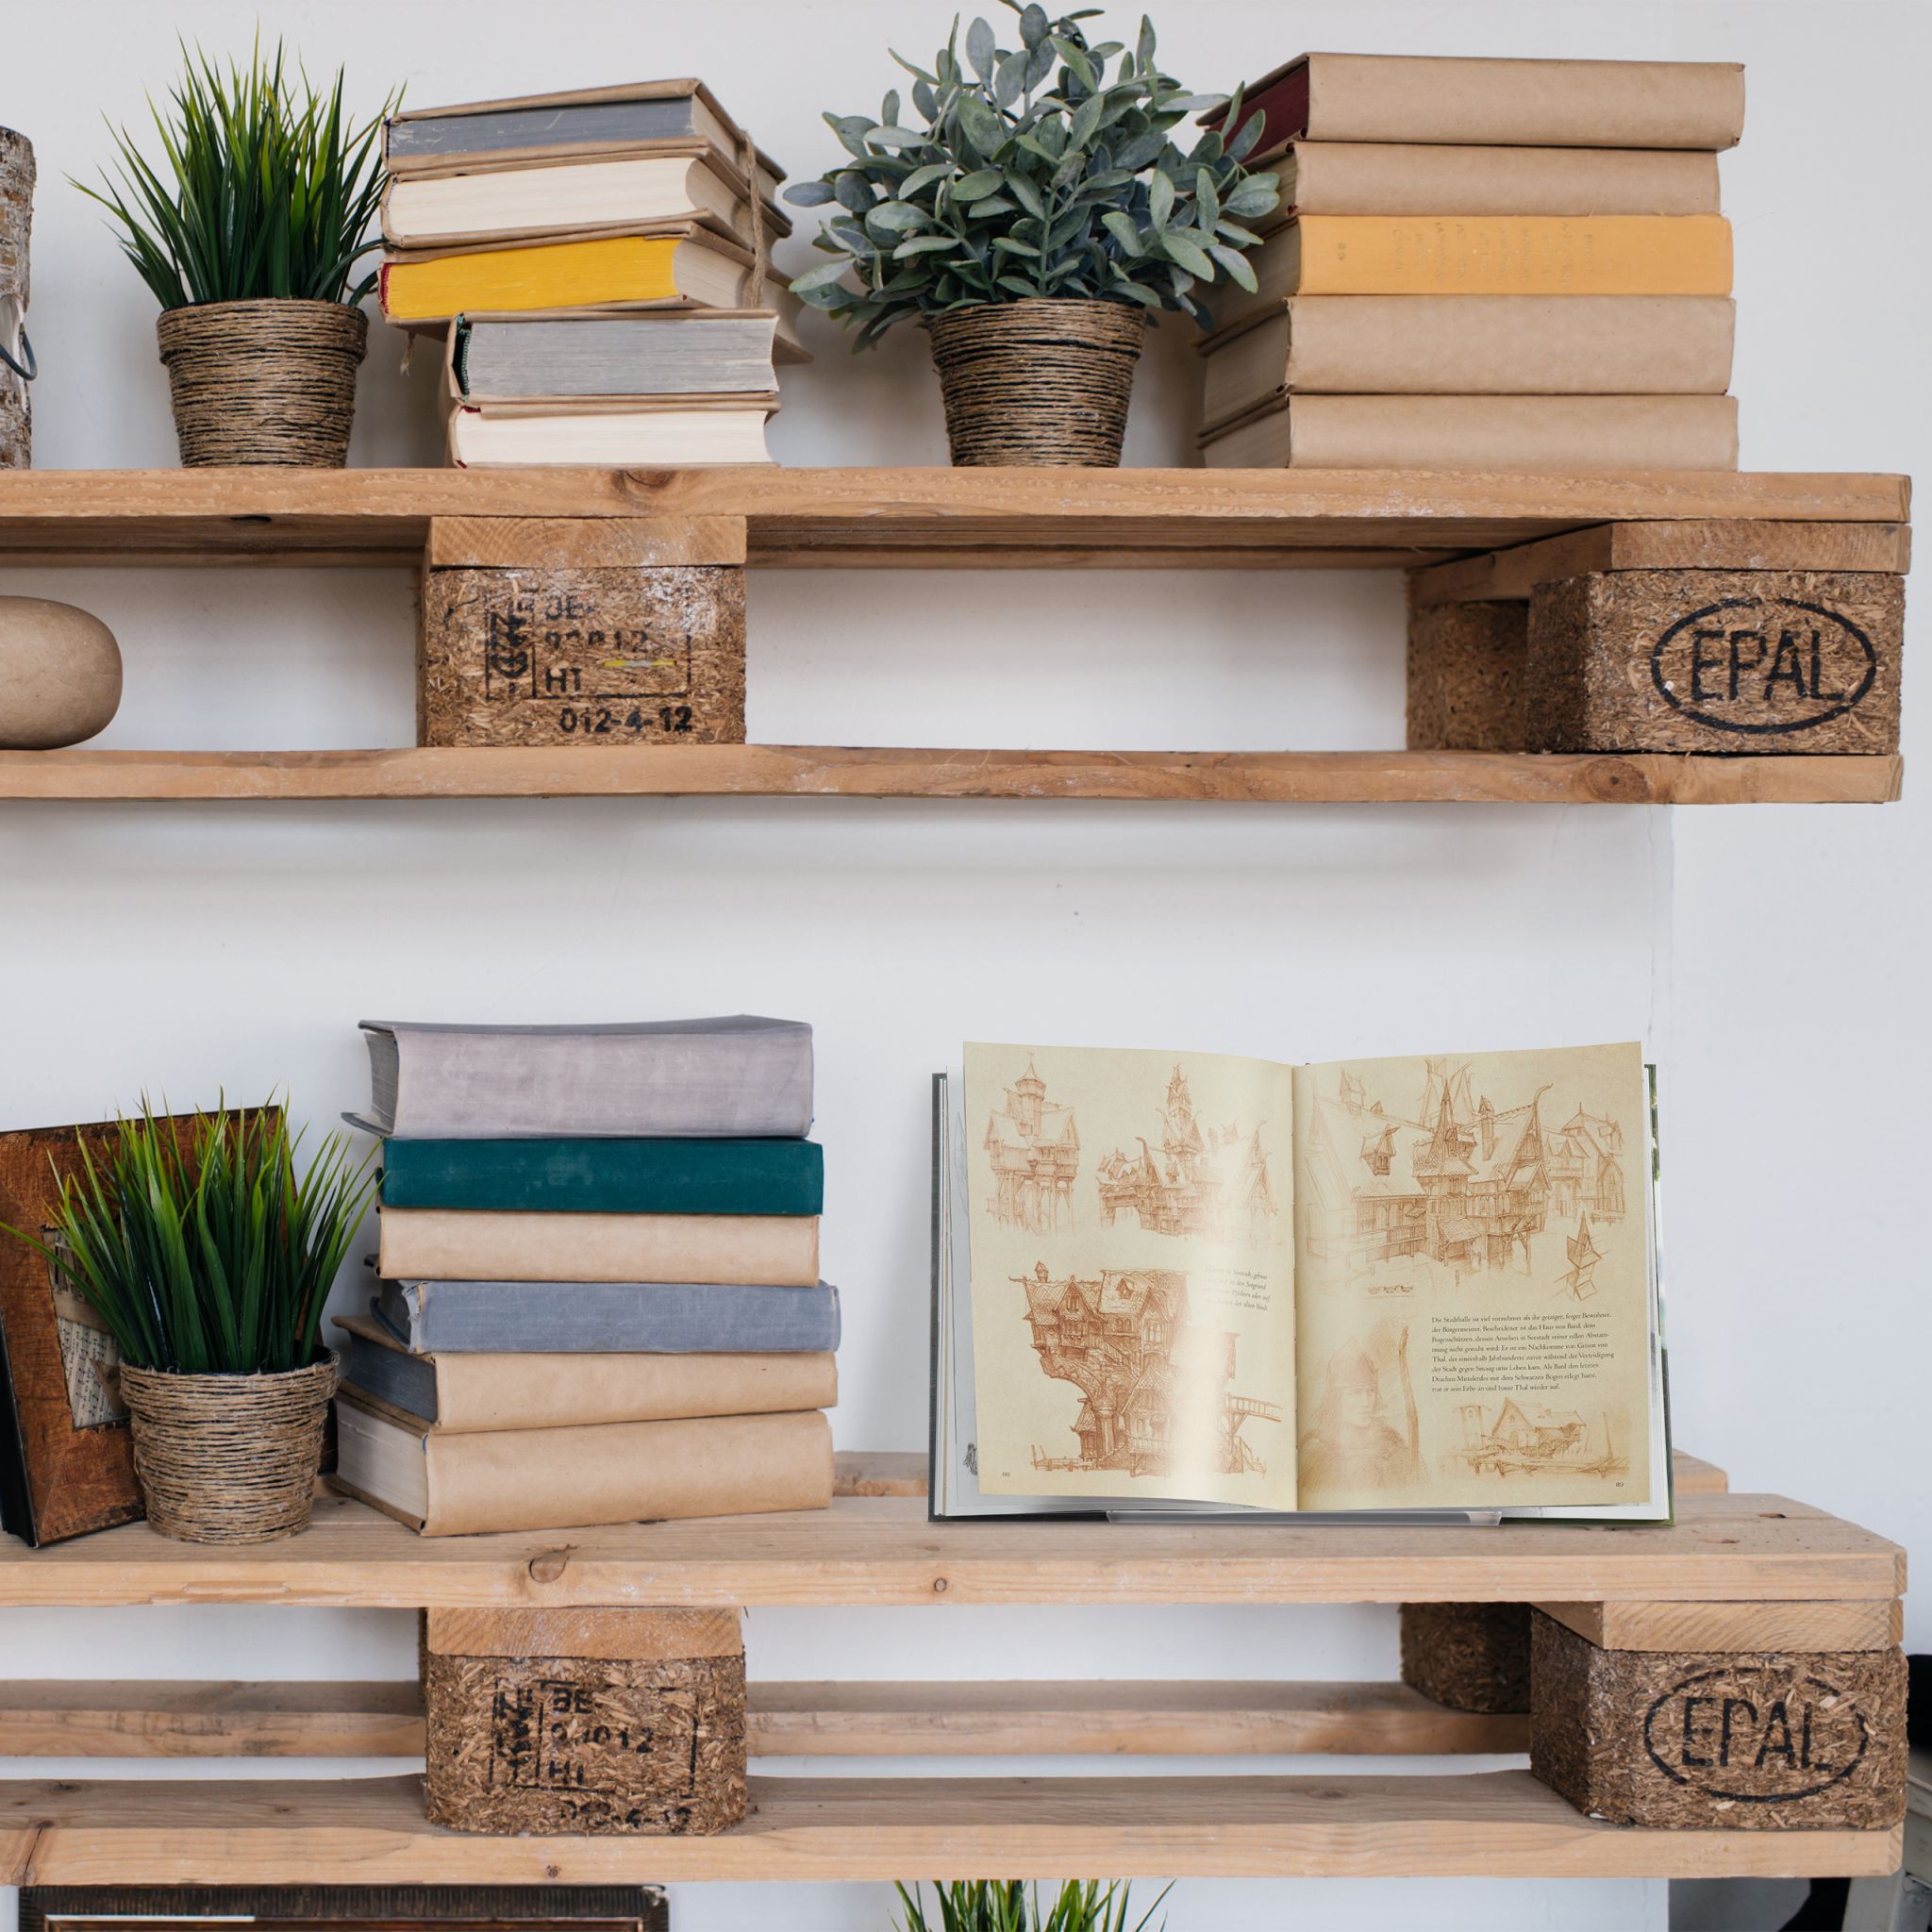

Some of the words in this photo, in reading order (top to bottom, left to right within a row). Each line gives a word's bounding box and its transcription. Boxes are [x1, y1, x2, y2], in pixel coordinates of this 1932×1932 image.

[545, 667, 581, 692] HT
[1690, 630, 1845, 701] EPAL
[1682, 1698, 1833, 1770] EPAL
